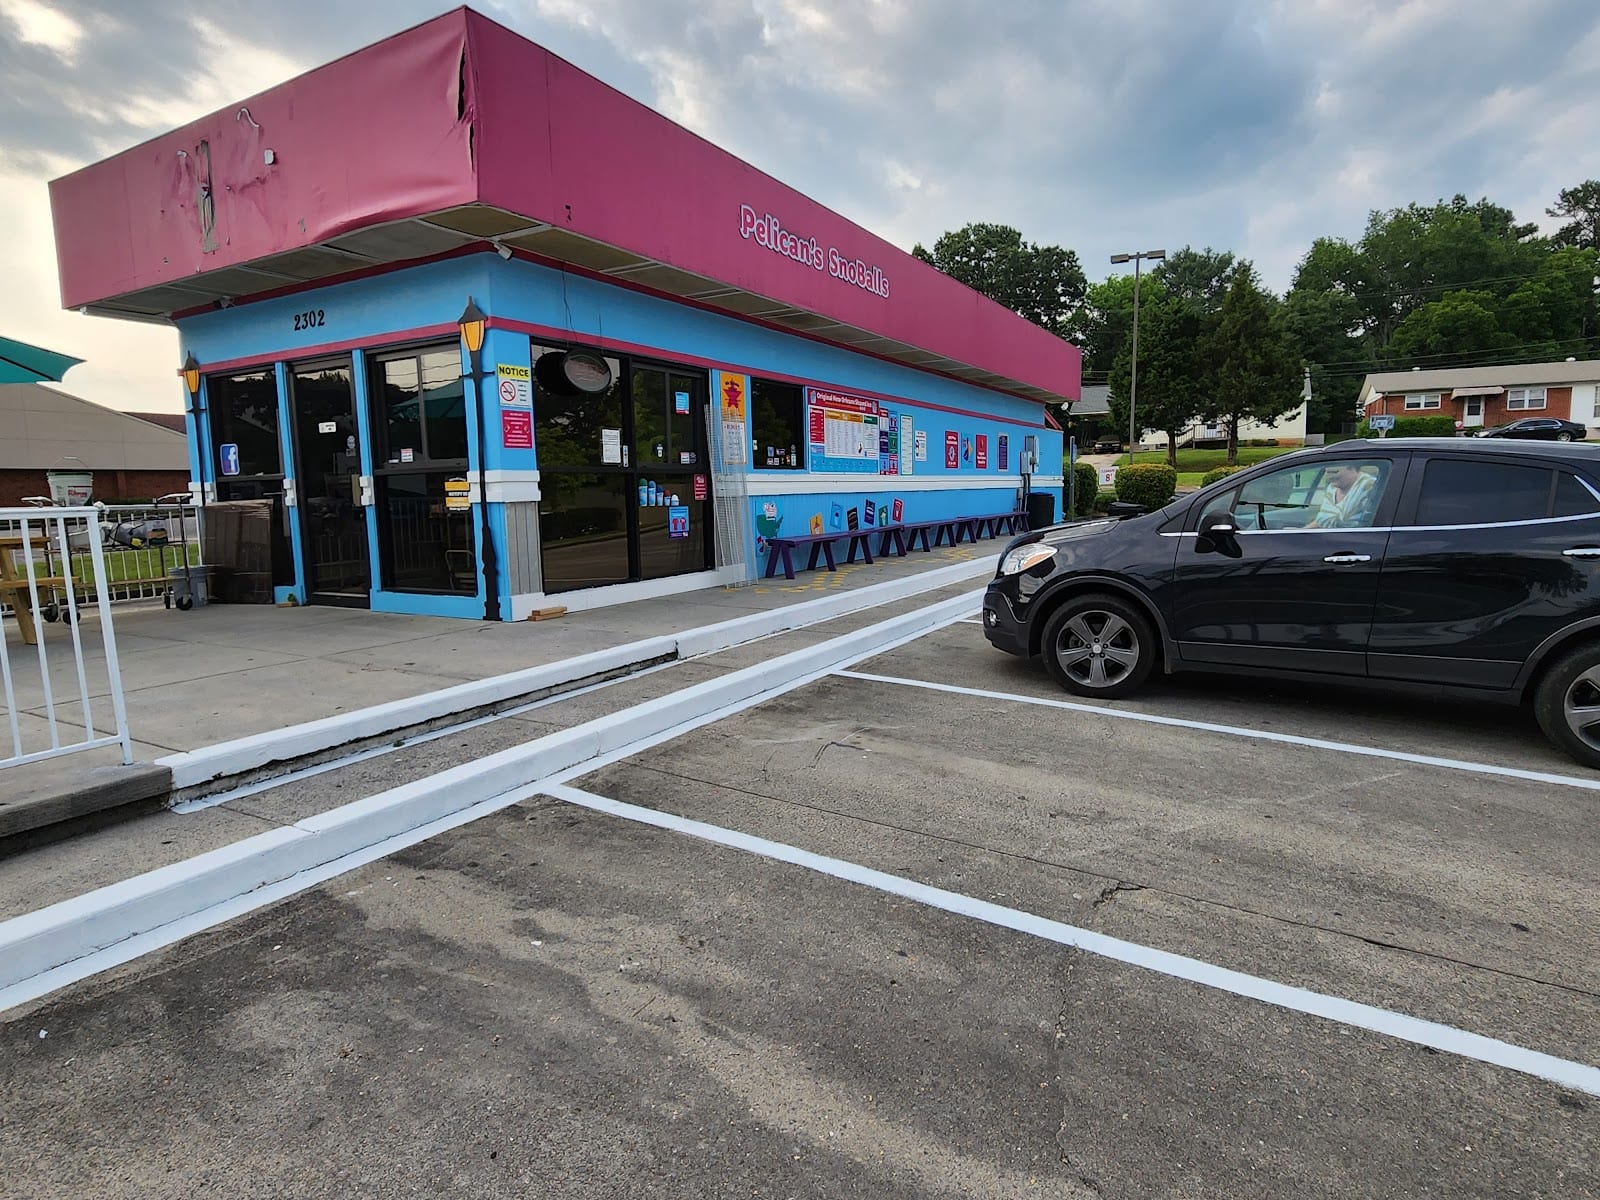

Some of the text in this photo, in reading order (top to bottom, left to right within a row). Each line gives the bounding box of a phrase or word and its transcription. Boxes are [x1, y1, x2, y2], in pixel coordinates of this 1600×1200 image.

[740, 204, 889, 298] Pelican's SnoBalls
[294, 310, 325, 331] 2302
[499, 366, 528, 377] NOTICE
[816, 392, 832, 401] Original
